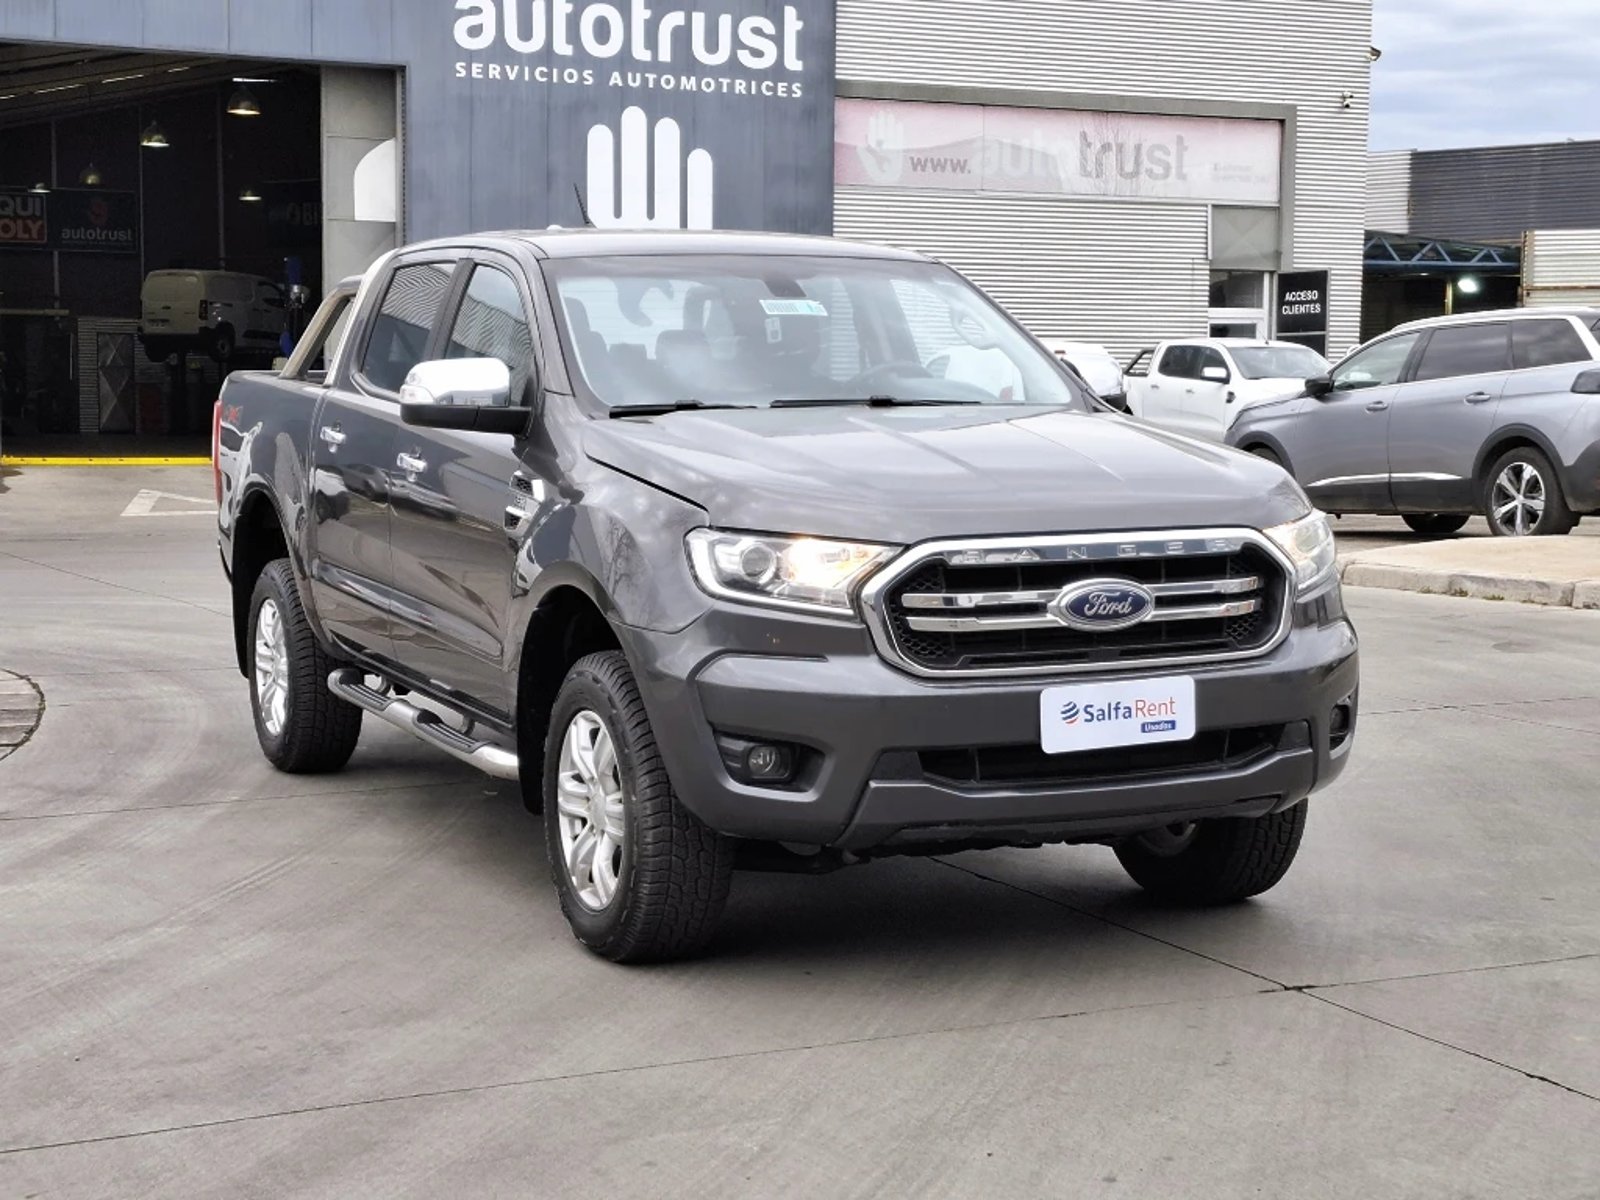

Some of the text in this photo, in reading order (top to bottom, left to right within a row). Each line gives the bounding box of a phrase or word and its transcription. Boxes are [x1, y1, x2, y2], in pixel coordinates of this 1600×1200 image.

[453, 0, 804, 71] autotrust
[455, 62, 803, 98] SERVICIOS AUTOMOTRICES
[61, 226, 133, 241] autotrust
[1284, 290, 1318, 301] ACCESO
[1282, 303, 1321, 315] CLIENTES
[961, 539, 1231, 563] RANGER
[1084, 591, 1133, 616] Ford
